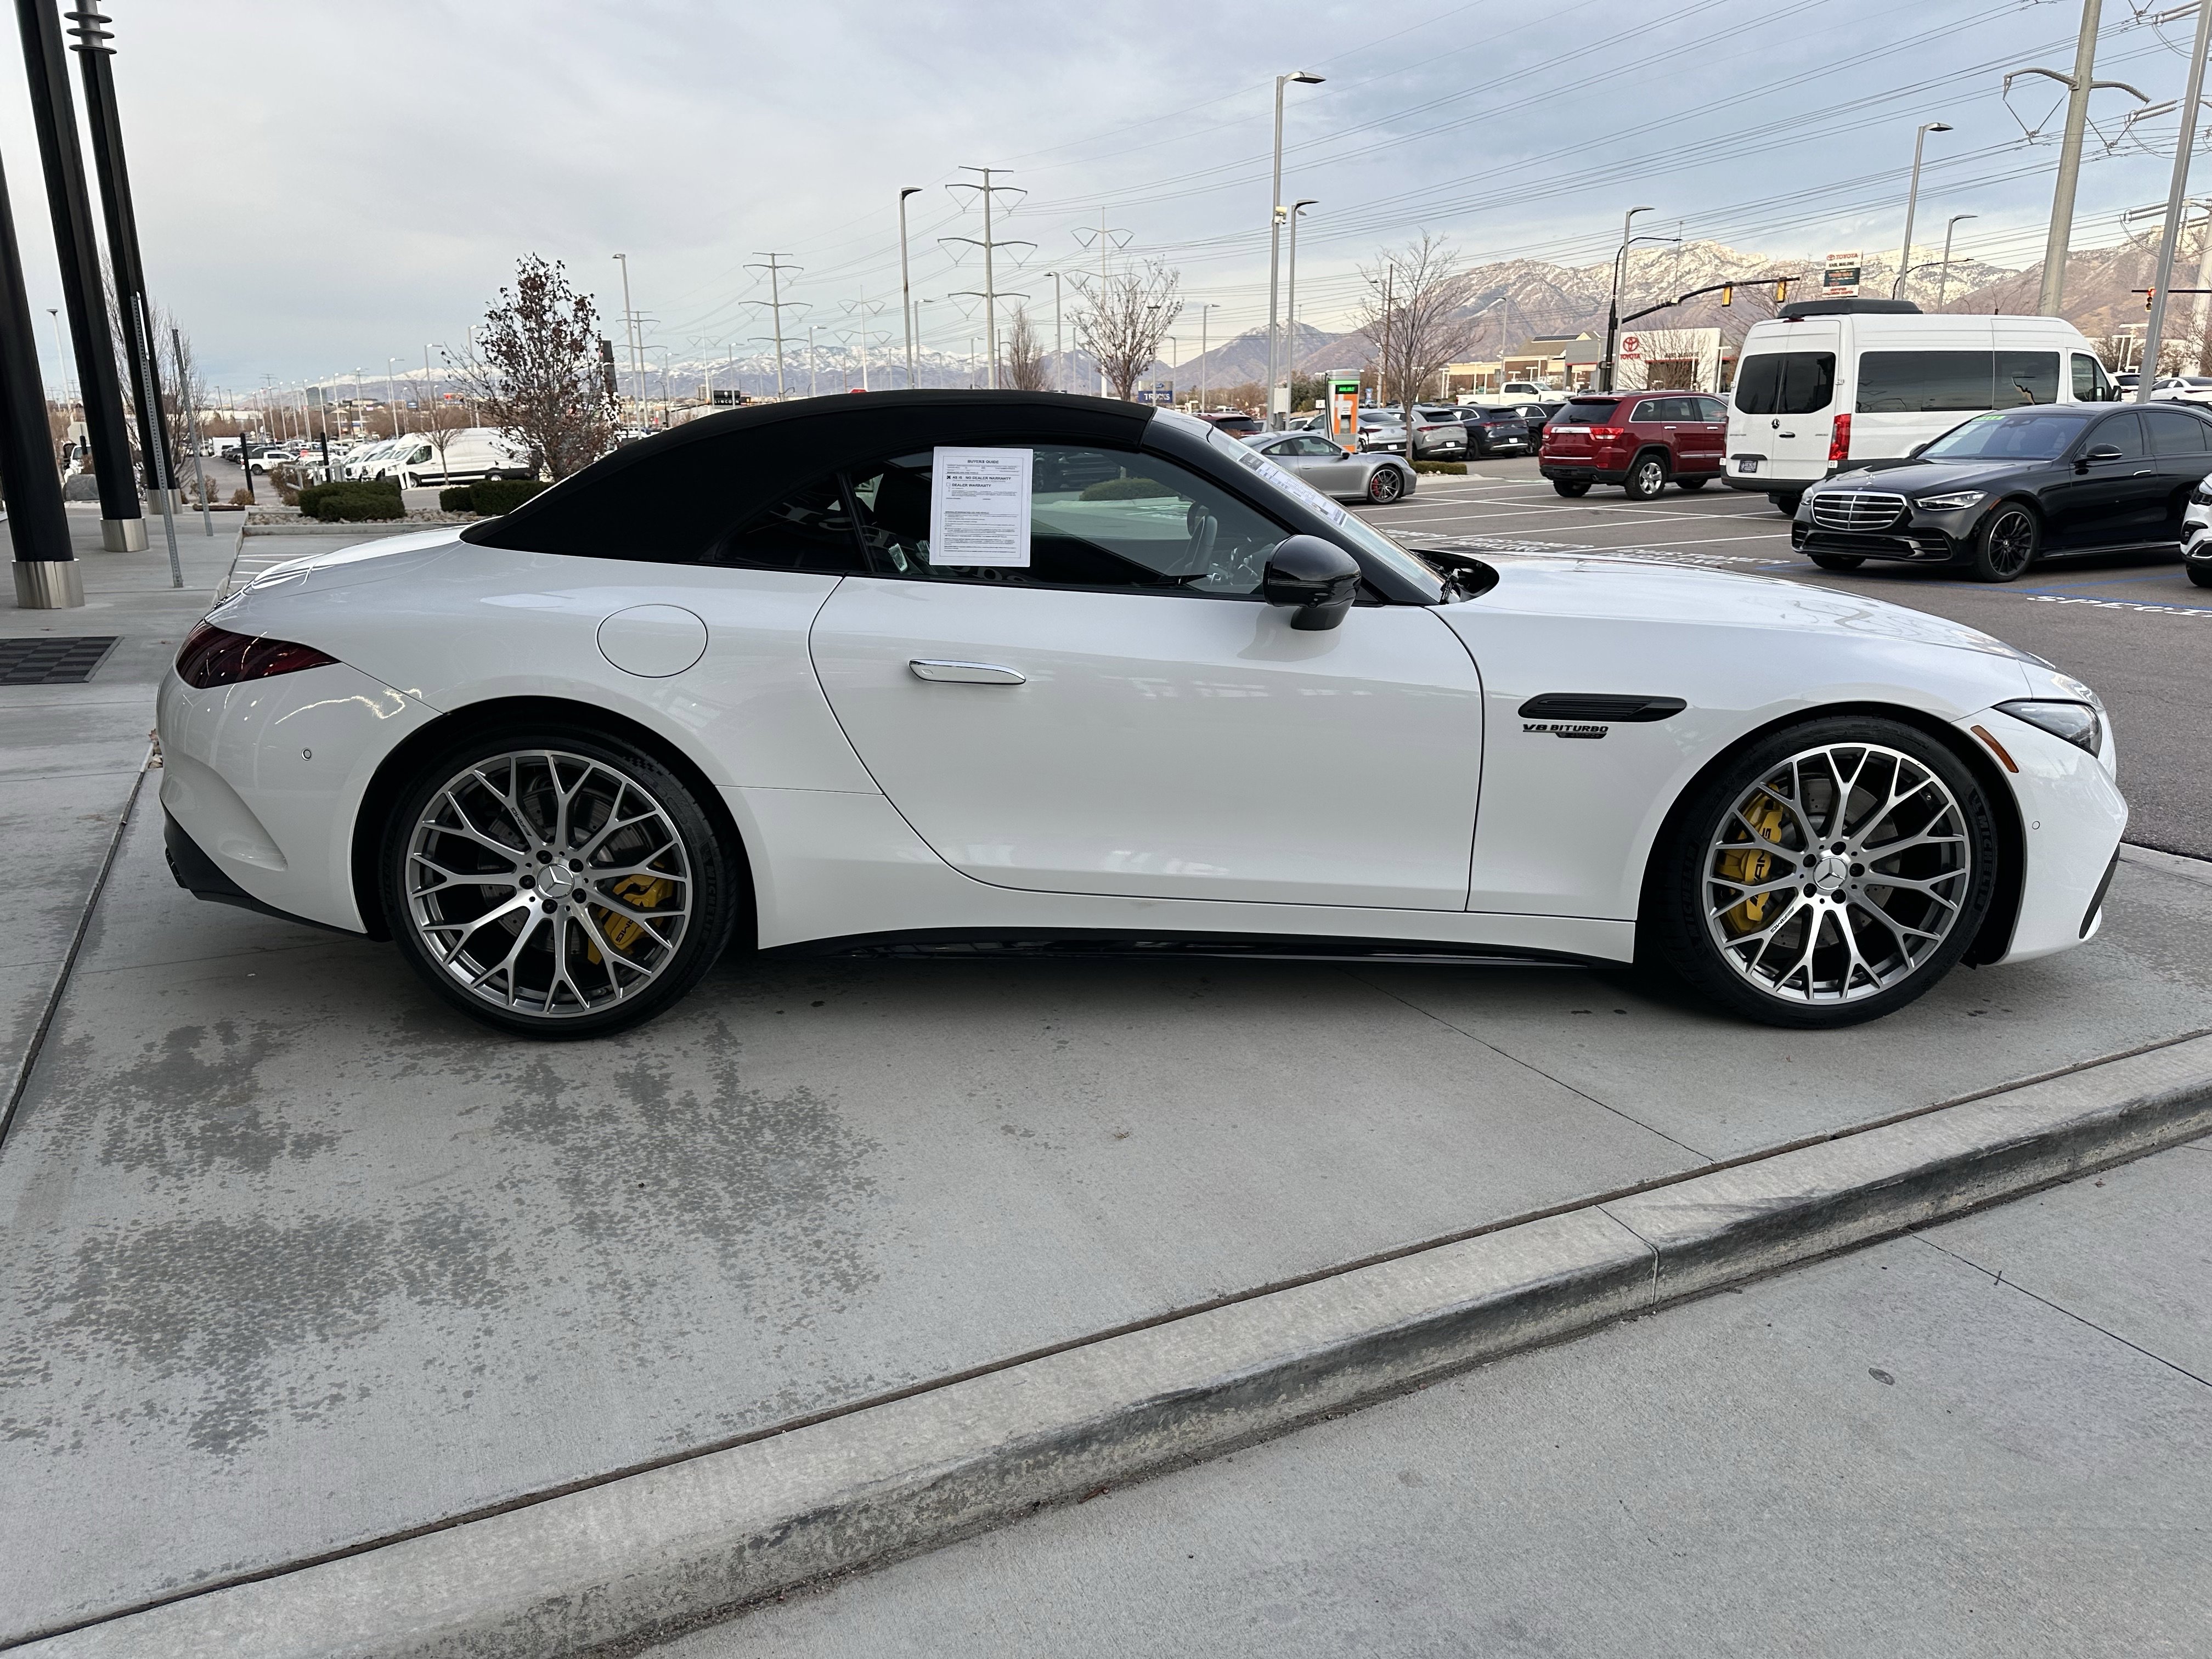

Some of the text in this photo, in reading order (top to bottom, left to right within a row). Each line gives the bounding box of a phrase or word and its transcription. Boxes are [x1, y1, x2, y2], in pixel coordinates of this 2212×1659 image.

[1550, 724, 1609, 732] BITURBO
[1976, 814, 1994, 906] MICHELIN
[701, 865, 717, 940] MICHELIN
